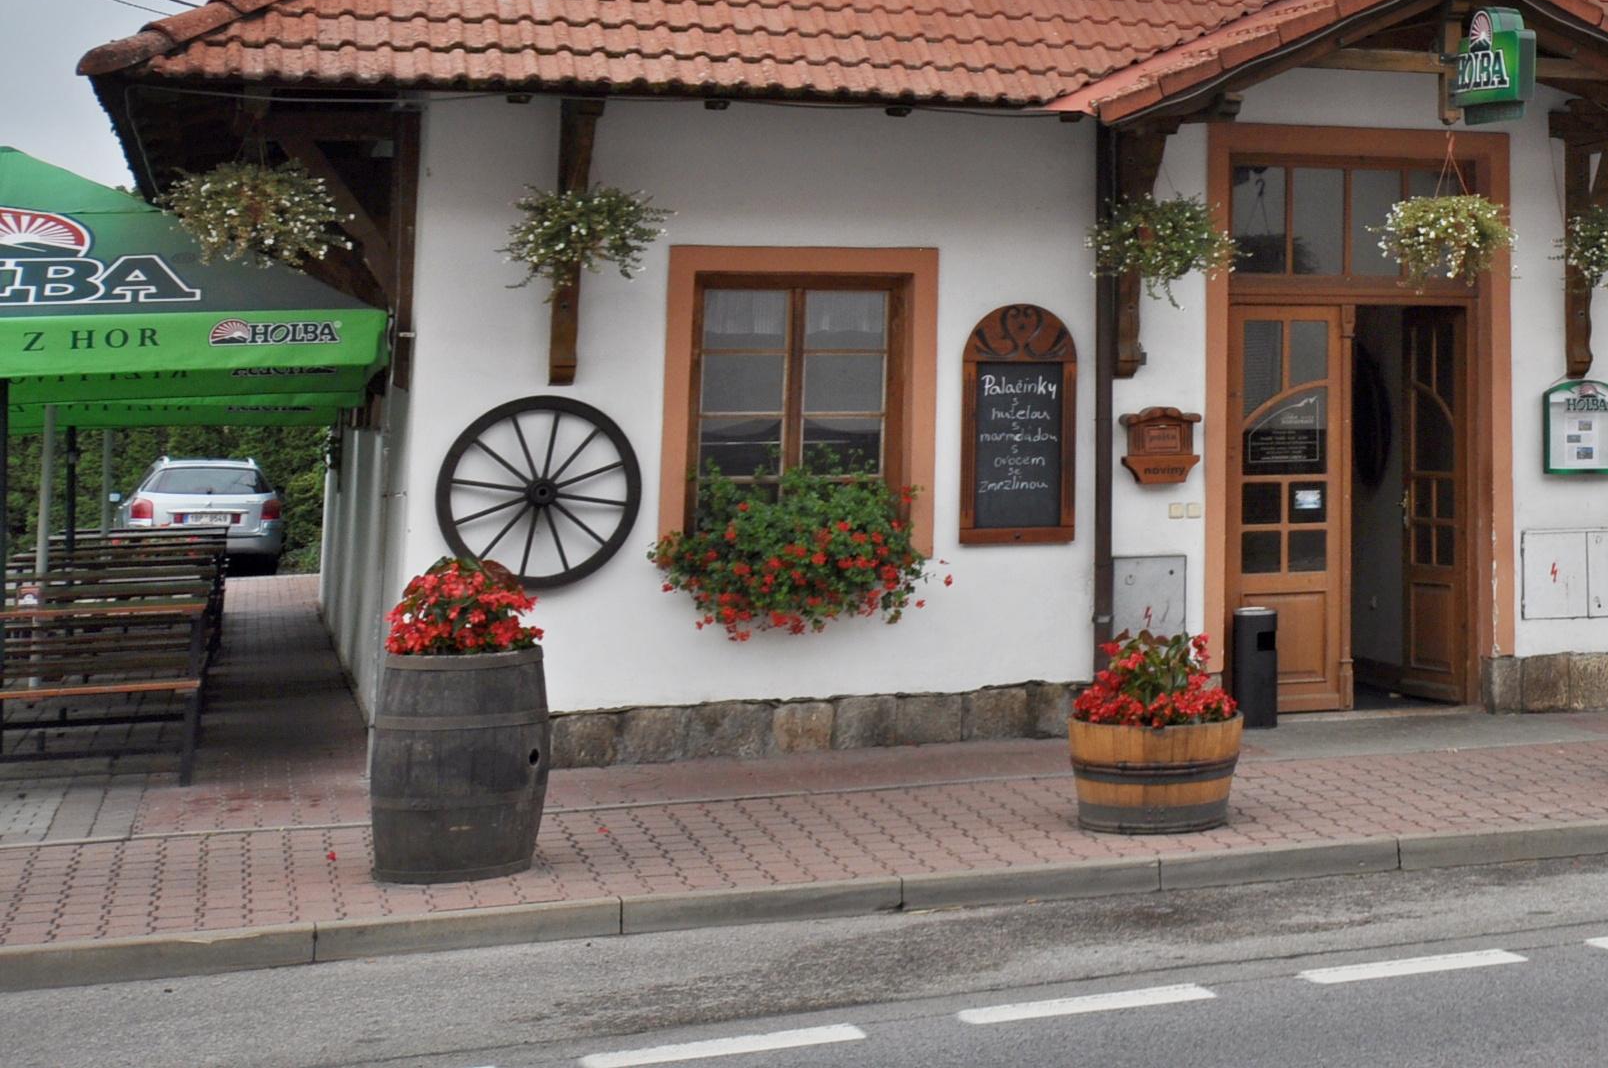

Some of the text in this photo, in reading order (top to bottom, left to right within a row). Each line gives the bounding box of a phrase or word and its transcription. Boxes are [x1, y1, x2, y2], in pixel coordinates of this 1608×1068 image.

[1455, 48, 1510, 92] HOLBA
[0, 255, 201, 305] BA
[22, 327, 161, 352] Z HOR
[247, 321, 340, 344] HOLBA
[1566, 398, 1608, 411] HOLBA
[1144, 464, 1186, 477] noviny
